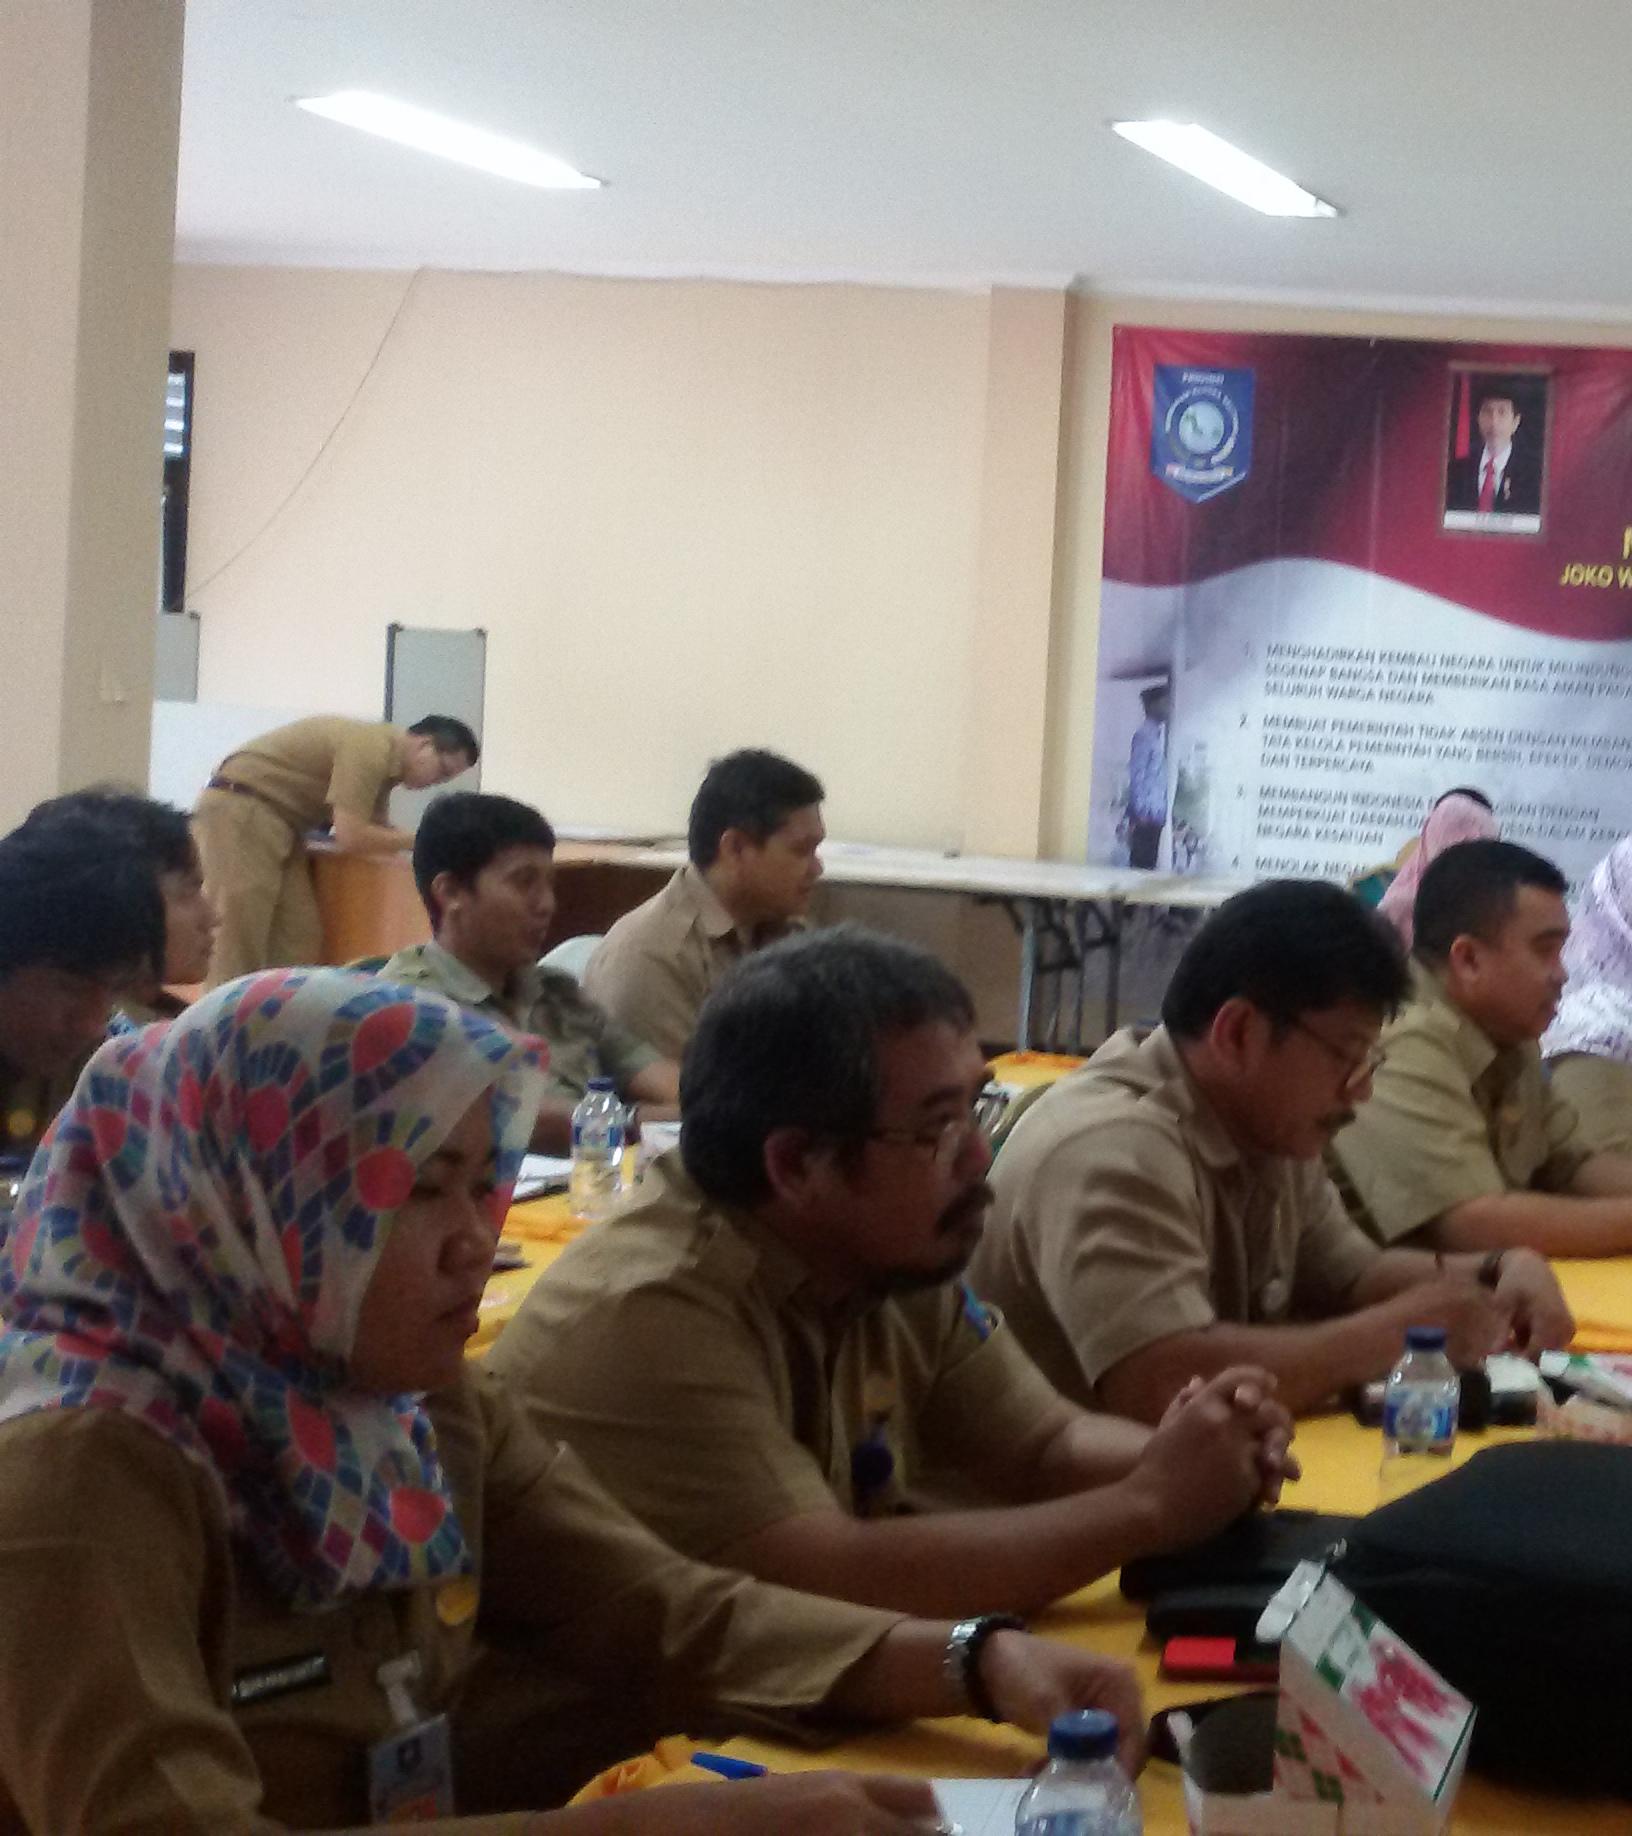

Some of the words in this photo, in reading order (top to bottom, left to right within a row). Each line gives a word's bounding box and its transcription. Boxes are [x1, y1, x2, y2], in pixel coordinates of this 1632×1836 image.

[1560, 563, 1614, 587] JOKO
[1266, 644, 1375, 665] MENGHADIRKAN
[1379, 650, 1436, 668] KEMBALI
[1440, 653, 1495, 672] NEGARA
[1499, 657, 1544, 675] UNTUK
[1265, 663, 1326, 680] SEGENAP
[1329, 667, 1383, 683] BANGSA
[1388, 670, 1417, 686] DAN
[1421, 672, 1510, 691] MEMBERIKAN
[1513, 677, 1548, 694] RASA
[1552, 679, 1594, 697] AMAN
[1598, 682, 1632, 699] PADA
[1265, 681, 1323, 699] SELURUH
[1327, 684, 1375, 701] WARGA
[1378, 687, 1434, 704] NEGARA
[1263, 714, 1327, 733] MEMBUAT
[1331, 718, 1415, 739] PEMERINTAH
[1418, 724, 1456, 741] TIDAK
[1460, 727, 1505, 744] ABSEN
[1508, 730, 1566, 748] DENGAN
[1263, 735, 1291, 751] TATA
[1295, 737, 1344, 754] KELOLA
[1349, 740, 1432, 760] PEMERINTAH
[1436, 745, 1471, 762] YANG
[1261, 753, 1290, 769] DAN
[1295, 755, 1375, 773] TERPERCAYA
[1258, 804, 1345, 824] MEMPERKUAT
[1259, 785, 1349, 804] MEMBANGUN
[1352, 791, 1423, 809] INDONESIA
[1543, 804, 1600, 822] DENGAN
[1257, 823, 1312, 841] NEGARA
[1315, 827, 1384, 846] KESATUAN
[1255, 856, 1318, 875] MENOLAK
